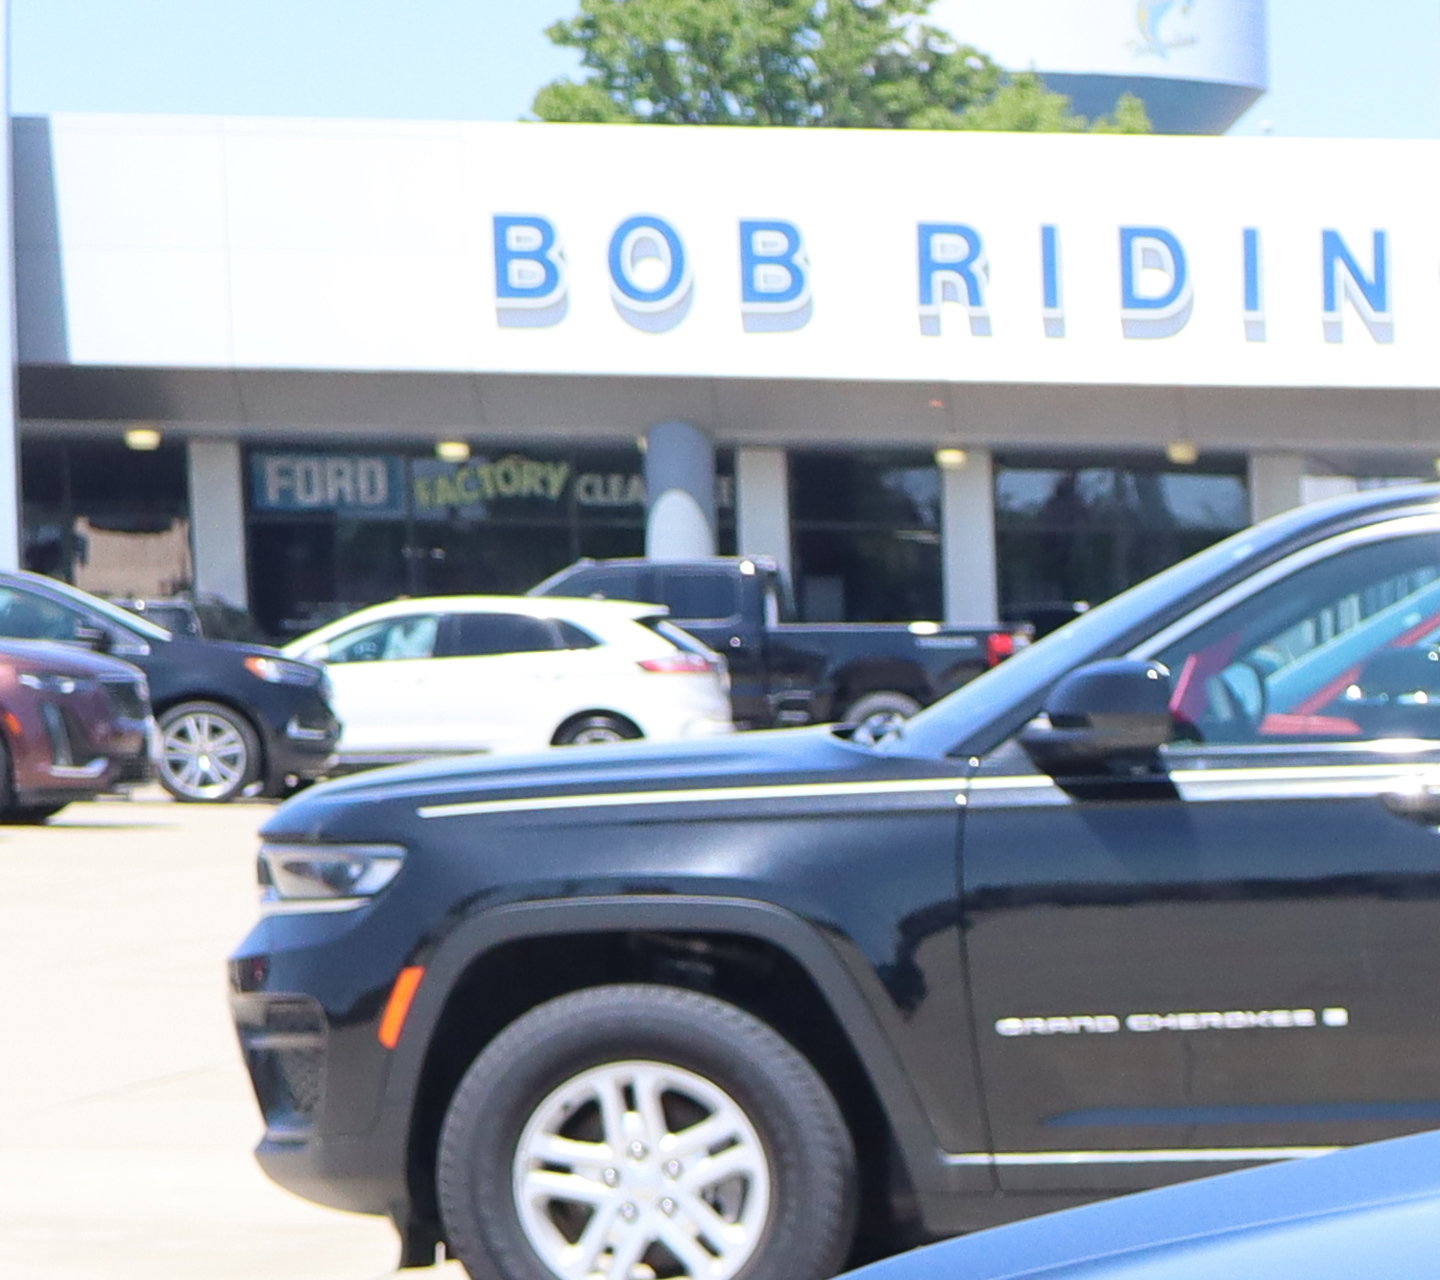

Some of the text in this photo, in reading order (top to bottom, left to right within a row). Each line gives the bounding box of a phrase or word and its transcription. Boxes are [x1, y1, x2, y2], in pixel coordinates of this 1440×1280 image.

[491, 212, 810, 308] BOB
[263, 456, 389, 506] FORD
[414, 457, 569, 504] FACTORY
[994, 1014, 1121, 1037] GRAND
[1124, 1008, 1318, 1033] CHEROKEE
